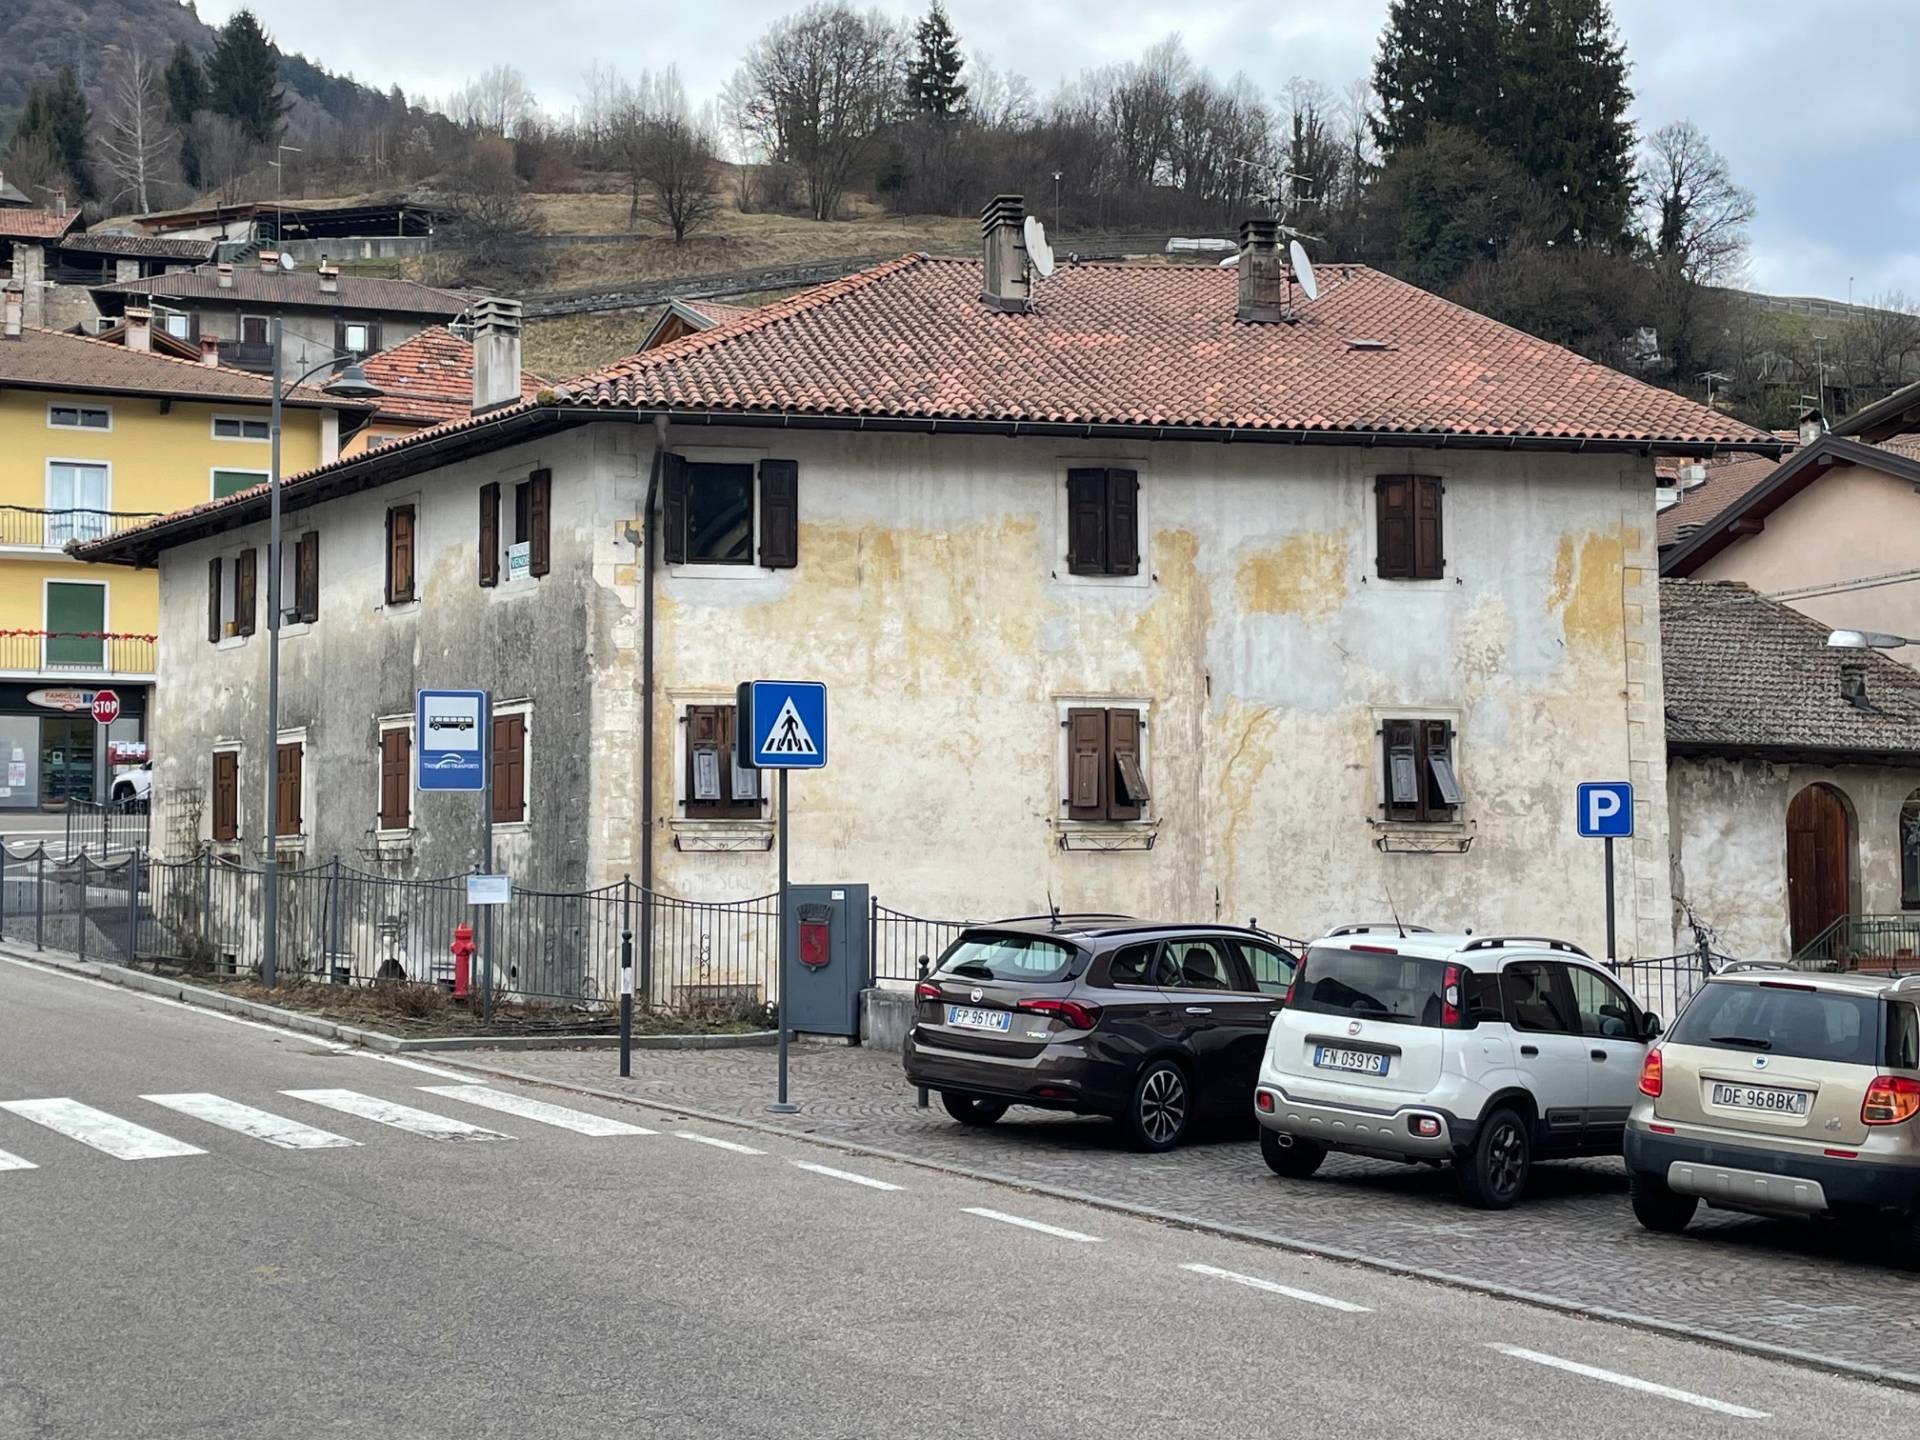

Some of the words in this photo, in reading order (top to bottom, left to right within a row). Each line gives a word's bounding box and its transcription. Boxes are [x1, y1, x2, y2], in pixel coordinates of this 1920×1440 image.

[93, 701, 118, 714] STOP
[1589, 789, 1621, 831] P
[956, 1009, 969, 1022] FP
[971, 1010, 1004, 1028] 961CW
[1322, 1048, 1338, 1065] FN
[1341, 1051, 1380, 1071] 039YS
[1723, 1087, 1742, 1105] DE
[1747, 1089, 1796, 1111] 968BK
